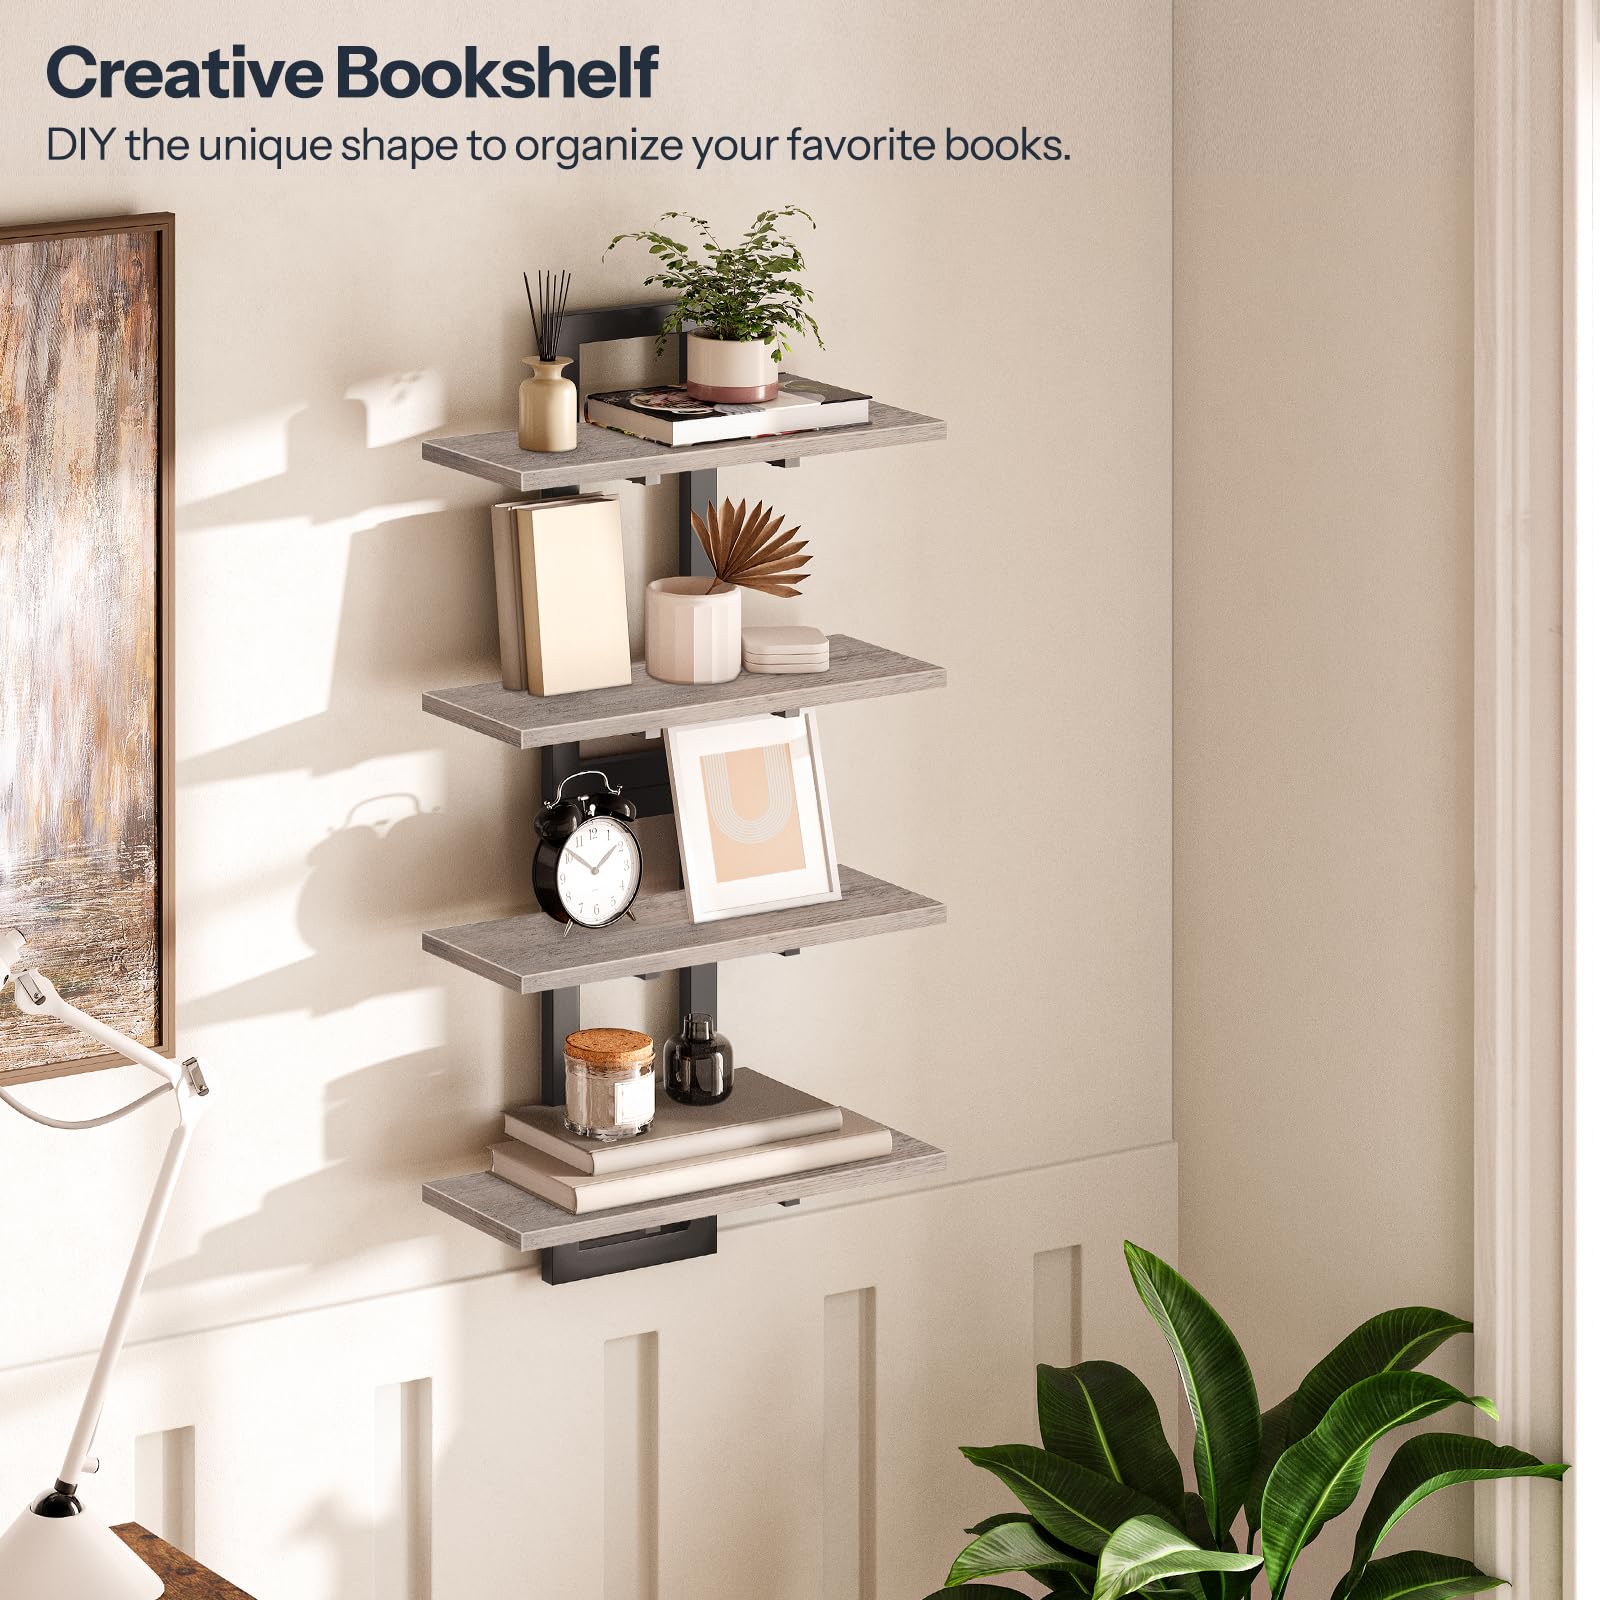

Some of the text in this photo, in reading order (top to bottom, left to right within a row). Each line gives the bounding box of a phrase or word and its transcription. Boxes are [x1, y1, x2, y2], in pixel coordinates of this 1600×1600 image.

[589, 828, 597, 840] 12
[575, 836, 583, 848] 11
[618, 842, 623, 852] 2
[565, 853, 573, 864] 10
[624, 861, 629, 871] 3
[560, 874, 566, 885] 9
[620, 880, 624, 891] 4
[566, 892, 572, 903] 8
[610, 896, 616, 907] 5
[579, 903, 584, 914] 7
[594, 904, 600, 915] 6
